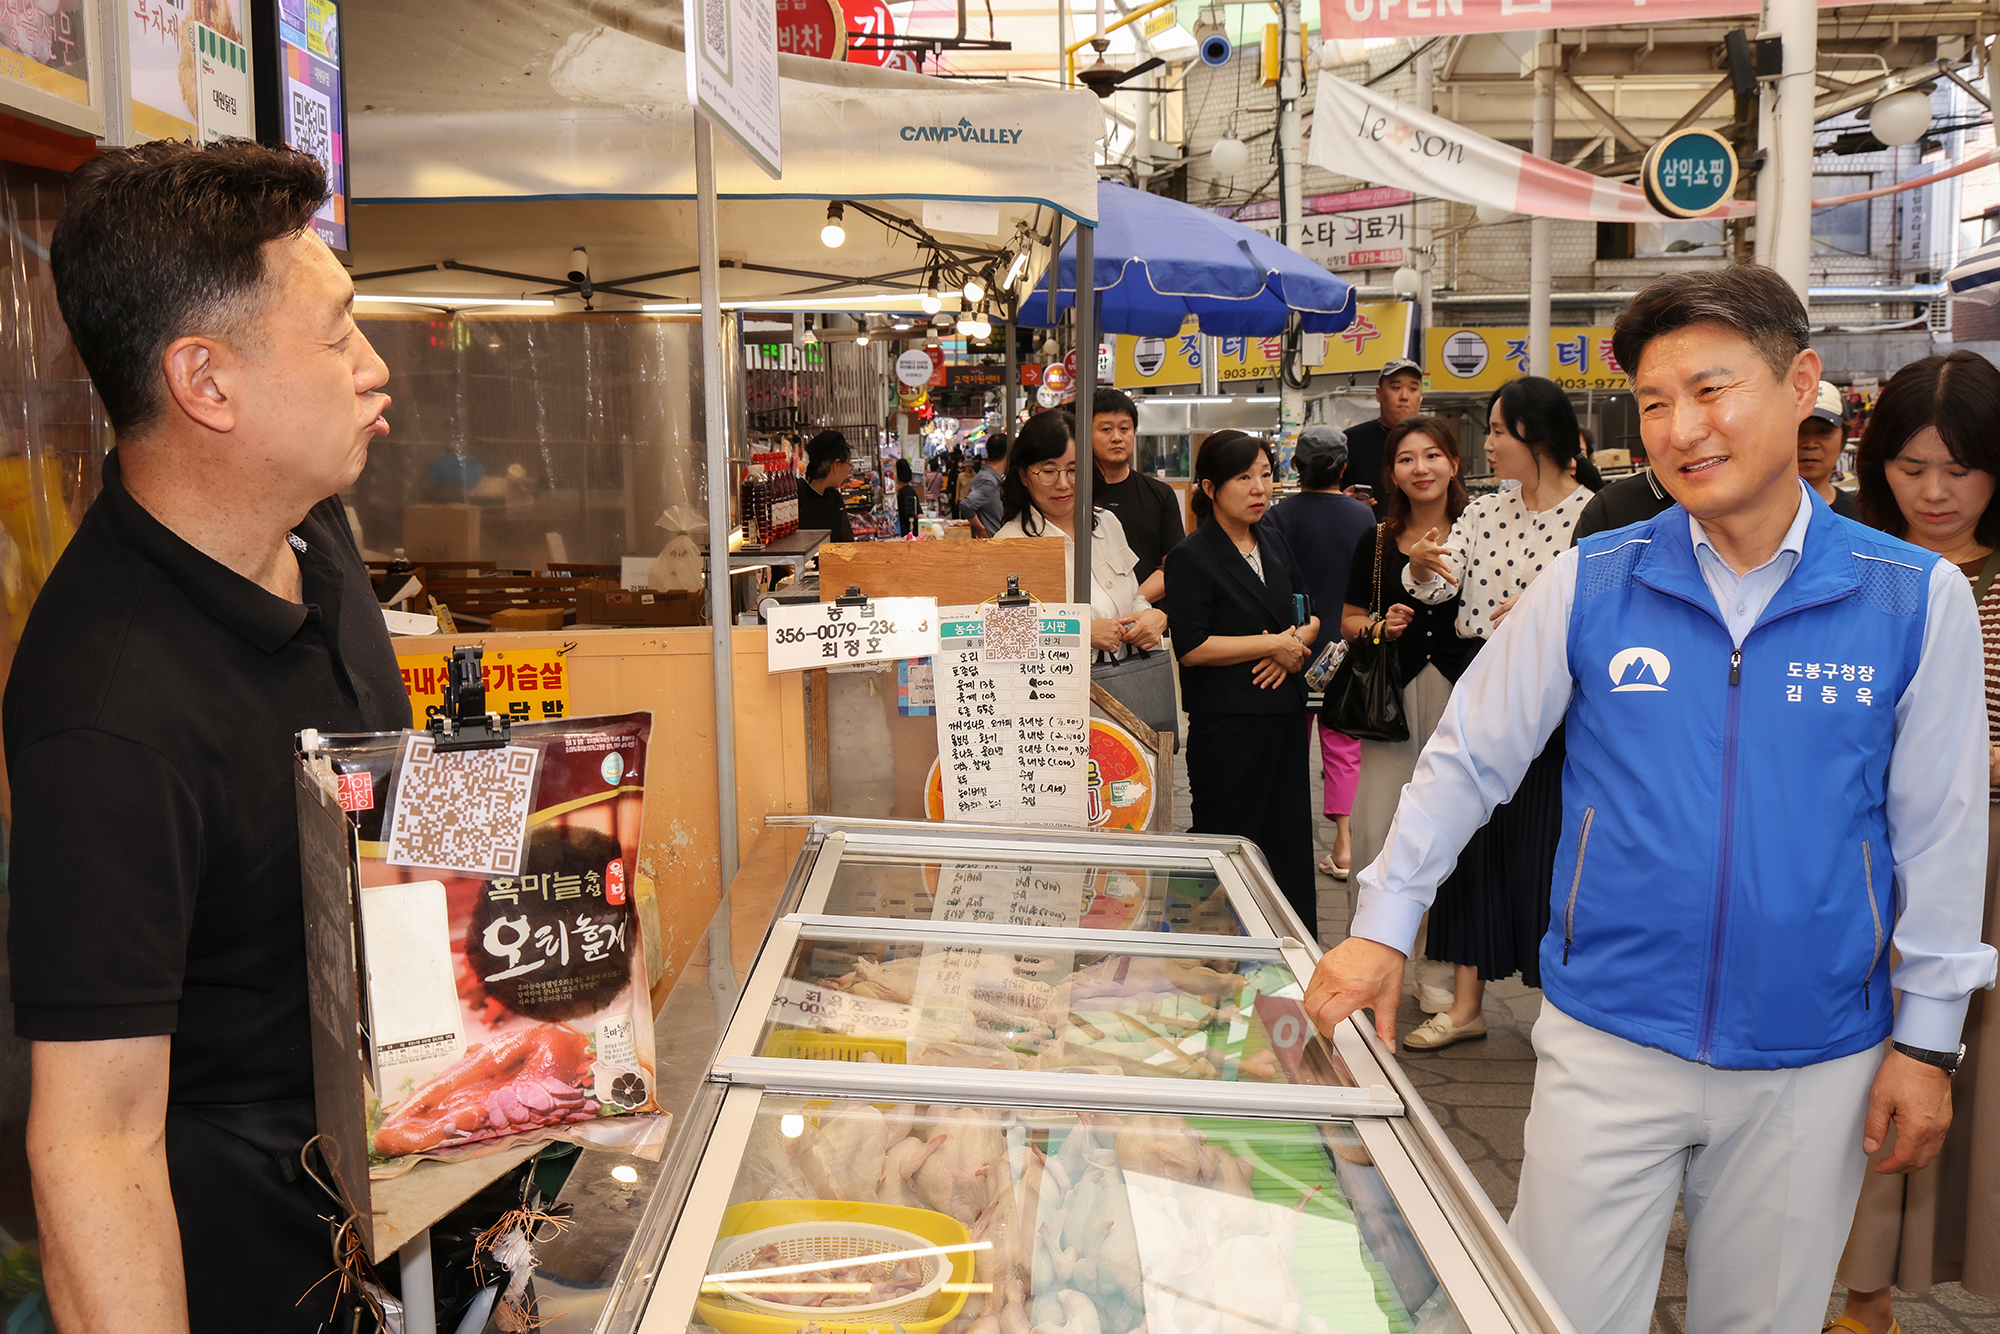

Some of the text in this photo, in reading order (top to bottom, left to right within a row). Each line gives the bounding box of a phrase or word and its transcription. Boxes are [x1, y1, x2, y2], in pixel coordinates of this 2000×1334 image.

[1345, 0, 1463, 22] OPEN
[0, 53, 25, 80] 닭집
[212, 89, 237, 115] 대원닭집
[900, 121, 1023, 145] CAMPVALLEY
[1662, 158, 1725, 188] 삼익쇼핑
[1345, 214, 1404, 244] 의료기
[1350, 249, 1402, 264] T.979-4845
[953, 374, 1001, 385] 고객지원센터
[654, 593, 688, 602] EGRANATES
[775, 619, 928, 644] 356-0079-2363
[822, 636, 883, 658] 최 정 호
[960, 651, 979, 663] 오리
[1020, 663, 1046, 675] 국내산
[1786, 661, 1876, 682] 도봉구청장
[1786, 684, 1874, 706] 김 동 욱
[1018, 717, 1044, 727] 국내산
[1018, 729, 1045, 741] 국내산
[1018, 744, 1043, 754] 국내산
[1018, 756, 1046, 767] 국내산
[1021, 783, 1036, 794] 수입
[1021, 796, 1036, 807] 수입
[488, 871, 582, 905] 흑마늘
[571, 912, 628, 962] 훈제
[483, 914, 570, 982] 오리
